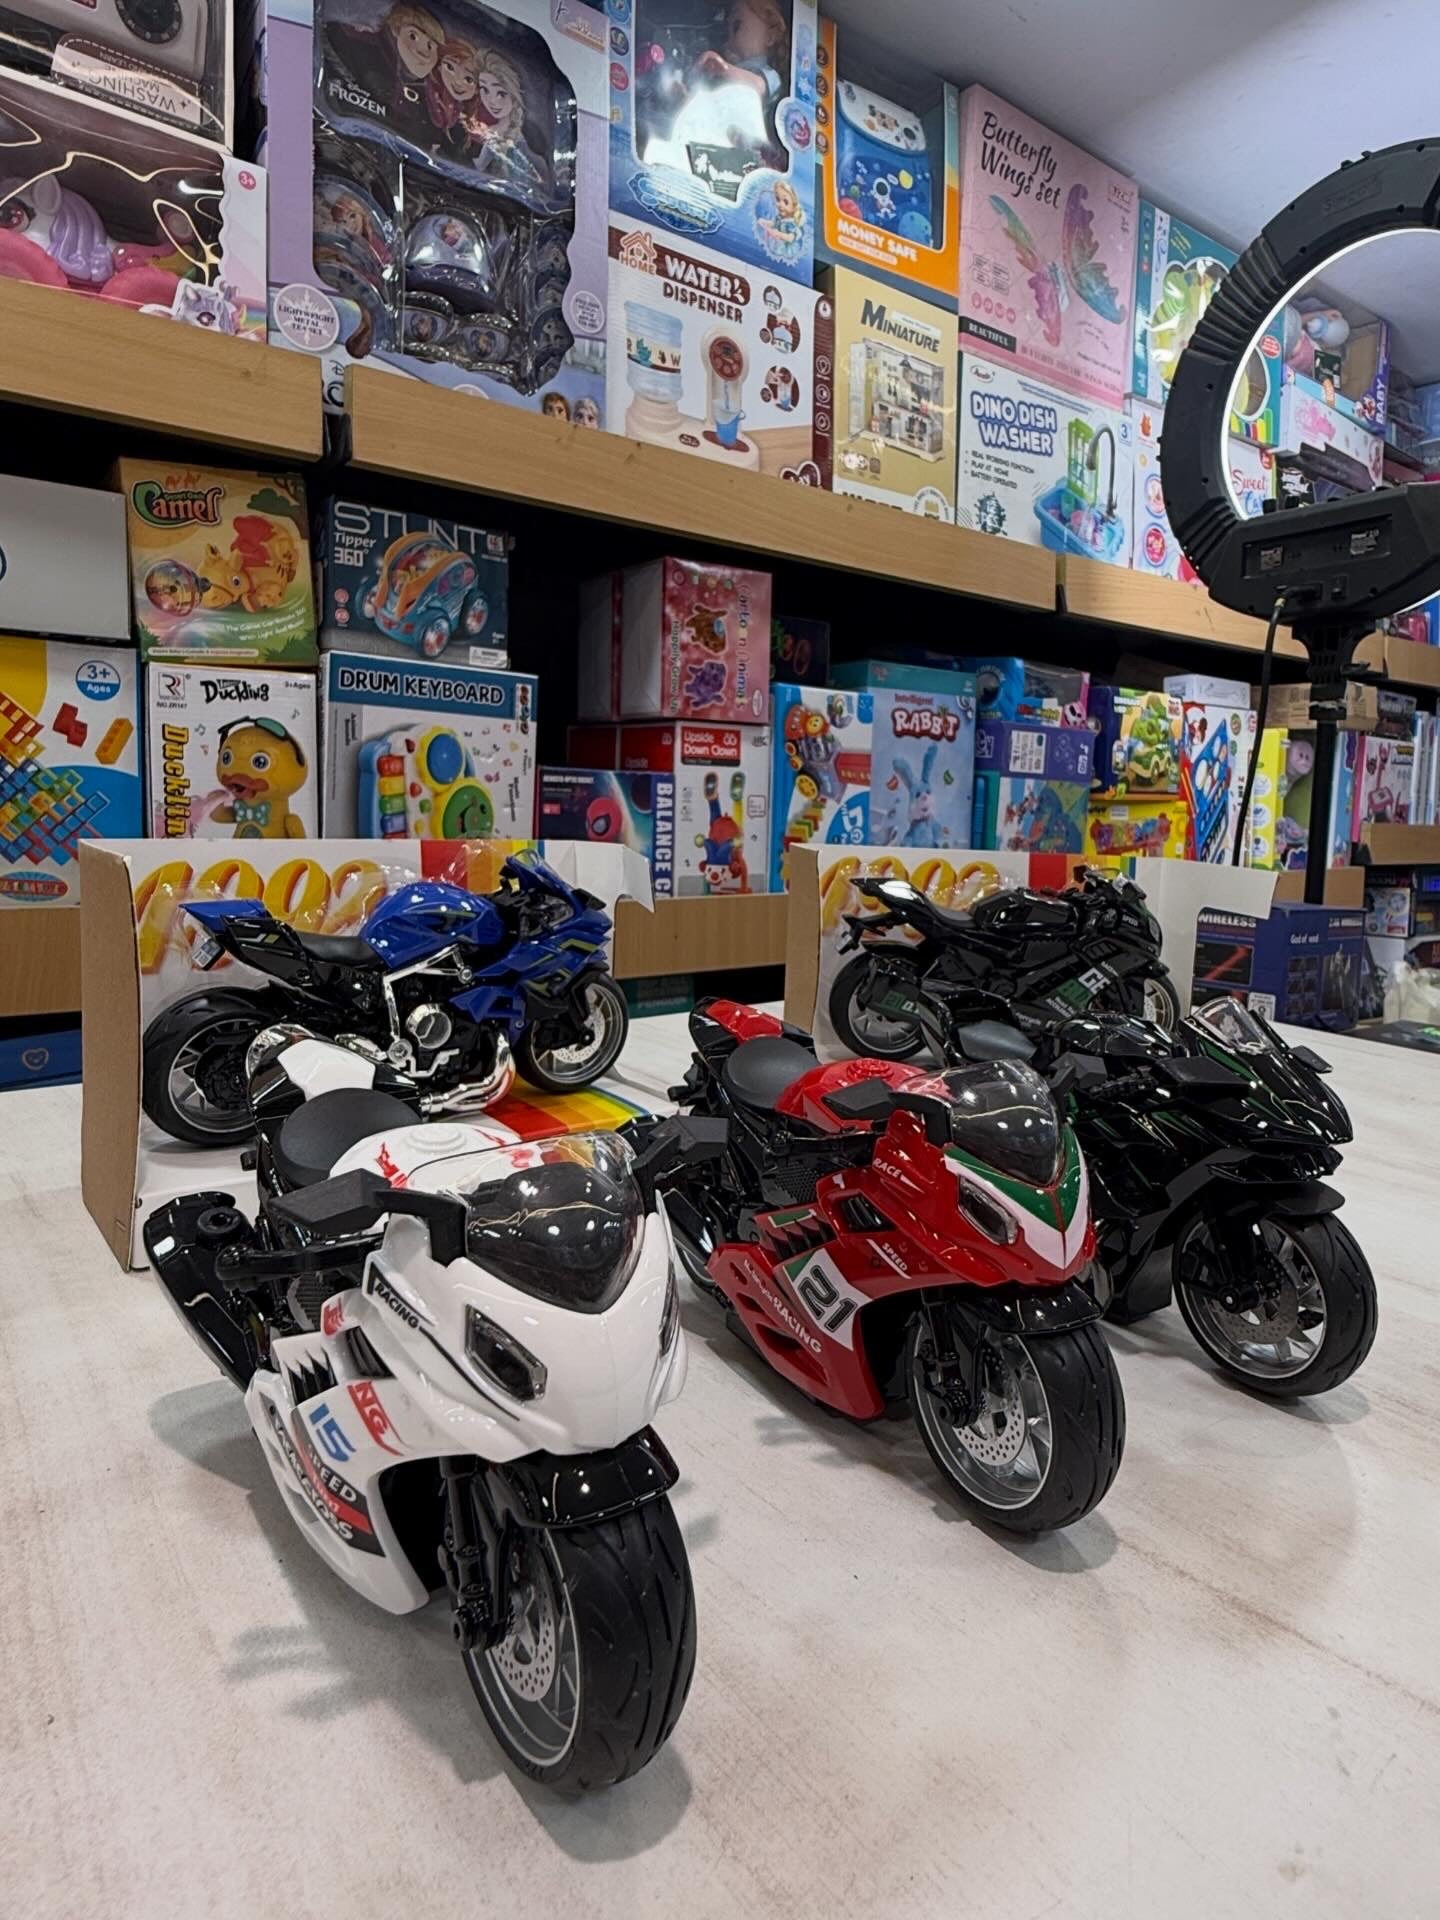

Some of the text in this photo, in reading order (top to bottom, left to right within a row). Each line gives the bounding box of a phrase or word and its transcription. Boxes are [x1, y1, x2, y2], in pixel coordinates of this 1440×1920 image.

[89, 70, 177, 114] WASHING
[329, 82, 387, 118] FROZEN
[981, 110, 1059, 182] Butterfly
[980, 142, 1035, 198] Wings
[837, 218, 885, 250] MONEY
[887, 239, 918, 263] SAFE
[619, 251, 657, 277] HOME
[664, 253, 733, 299] WATER
[663, 281, 744, 325] DISPENSER
[861, 298, 941, 354] MINIATURE
[970, 390, 1017, 425] DINO
[1017, 401, 1058, 432] DISH
[1375, 378, 1385, 425] BABY
[979, 418, 1054, 457] WASHER
[131, 480, 223, 528] Camel
[1231, 468, 1266, 498] Sweet
[333, 531, 377, 550] Tipper
[86, 682, 112, 695] Ages
[87, 664, 111, 682] 3+
[339, 668, 505, 706] DRUM KEYBOARD
[683, 731, 715, 745] Upside
[683, 743, 711, 756] Down
[654, 782, 674, 873] BALANCE
[1198, 912, 1258, 928] WIRELESS
[871, 1157, 903, 1179] RACE
[881, 1242, 909, 1272] SPEED
[374, 1280, 420, 1330] RACING
[799, 1263, 860, 1333] 21
[773, 1294, 823, 1354] RACING
[308, 1402, 357, 1463] 15
